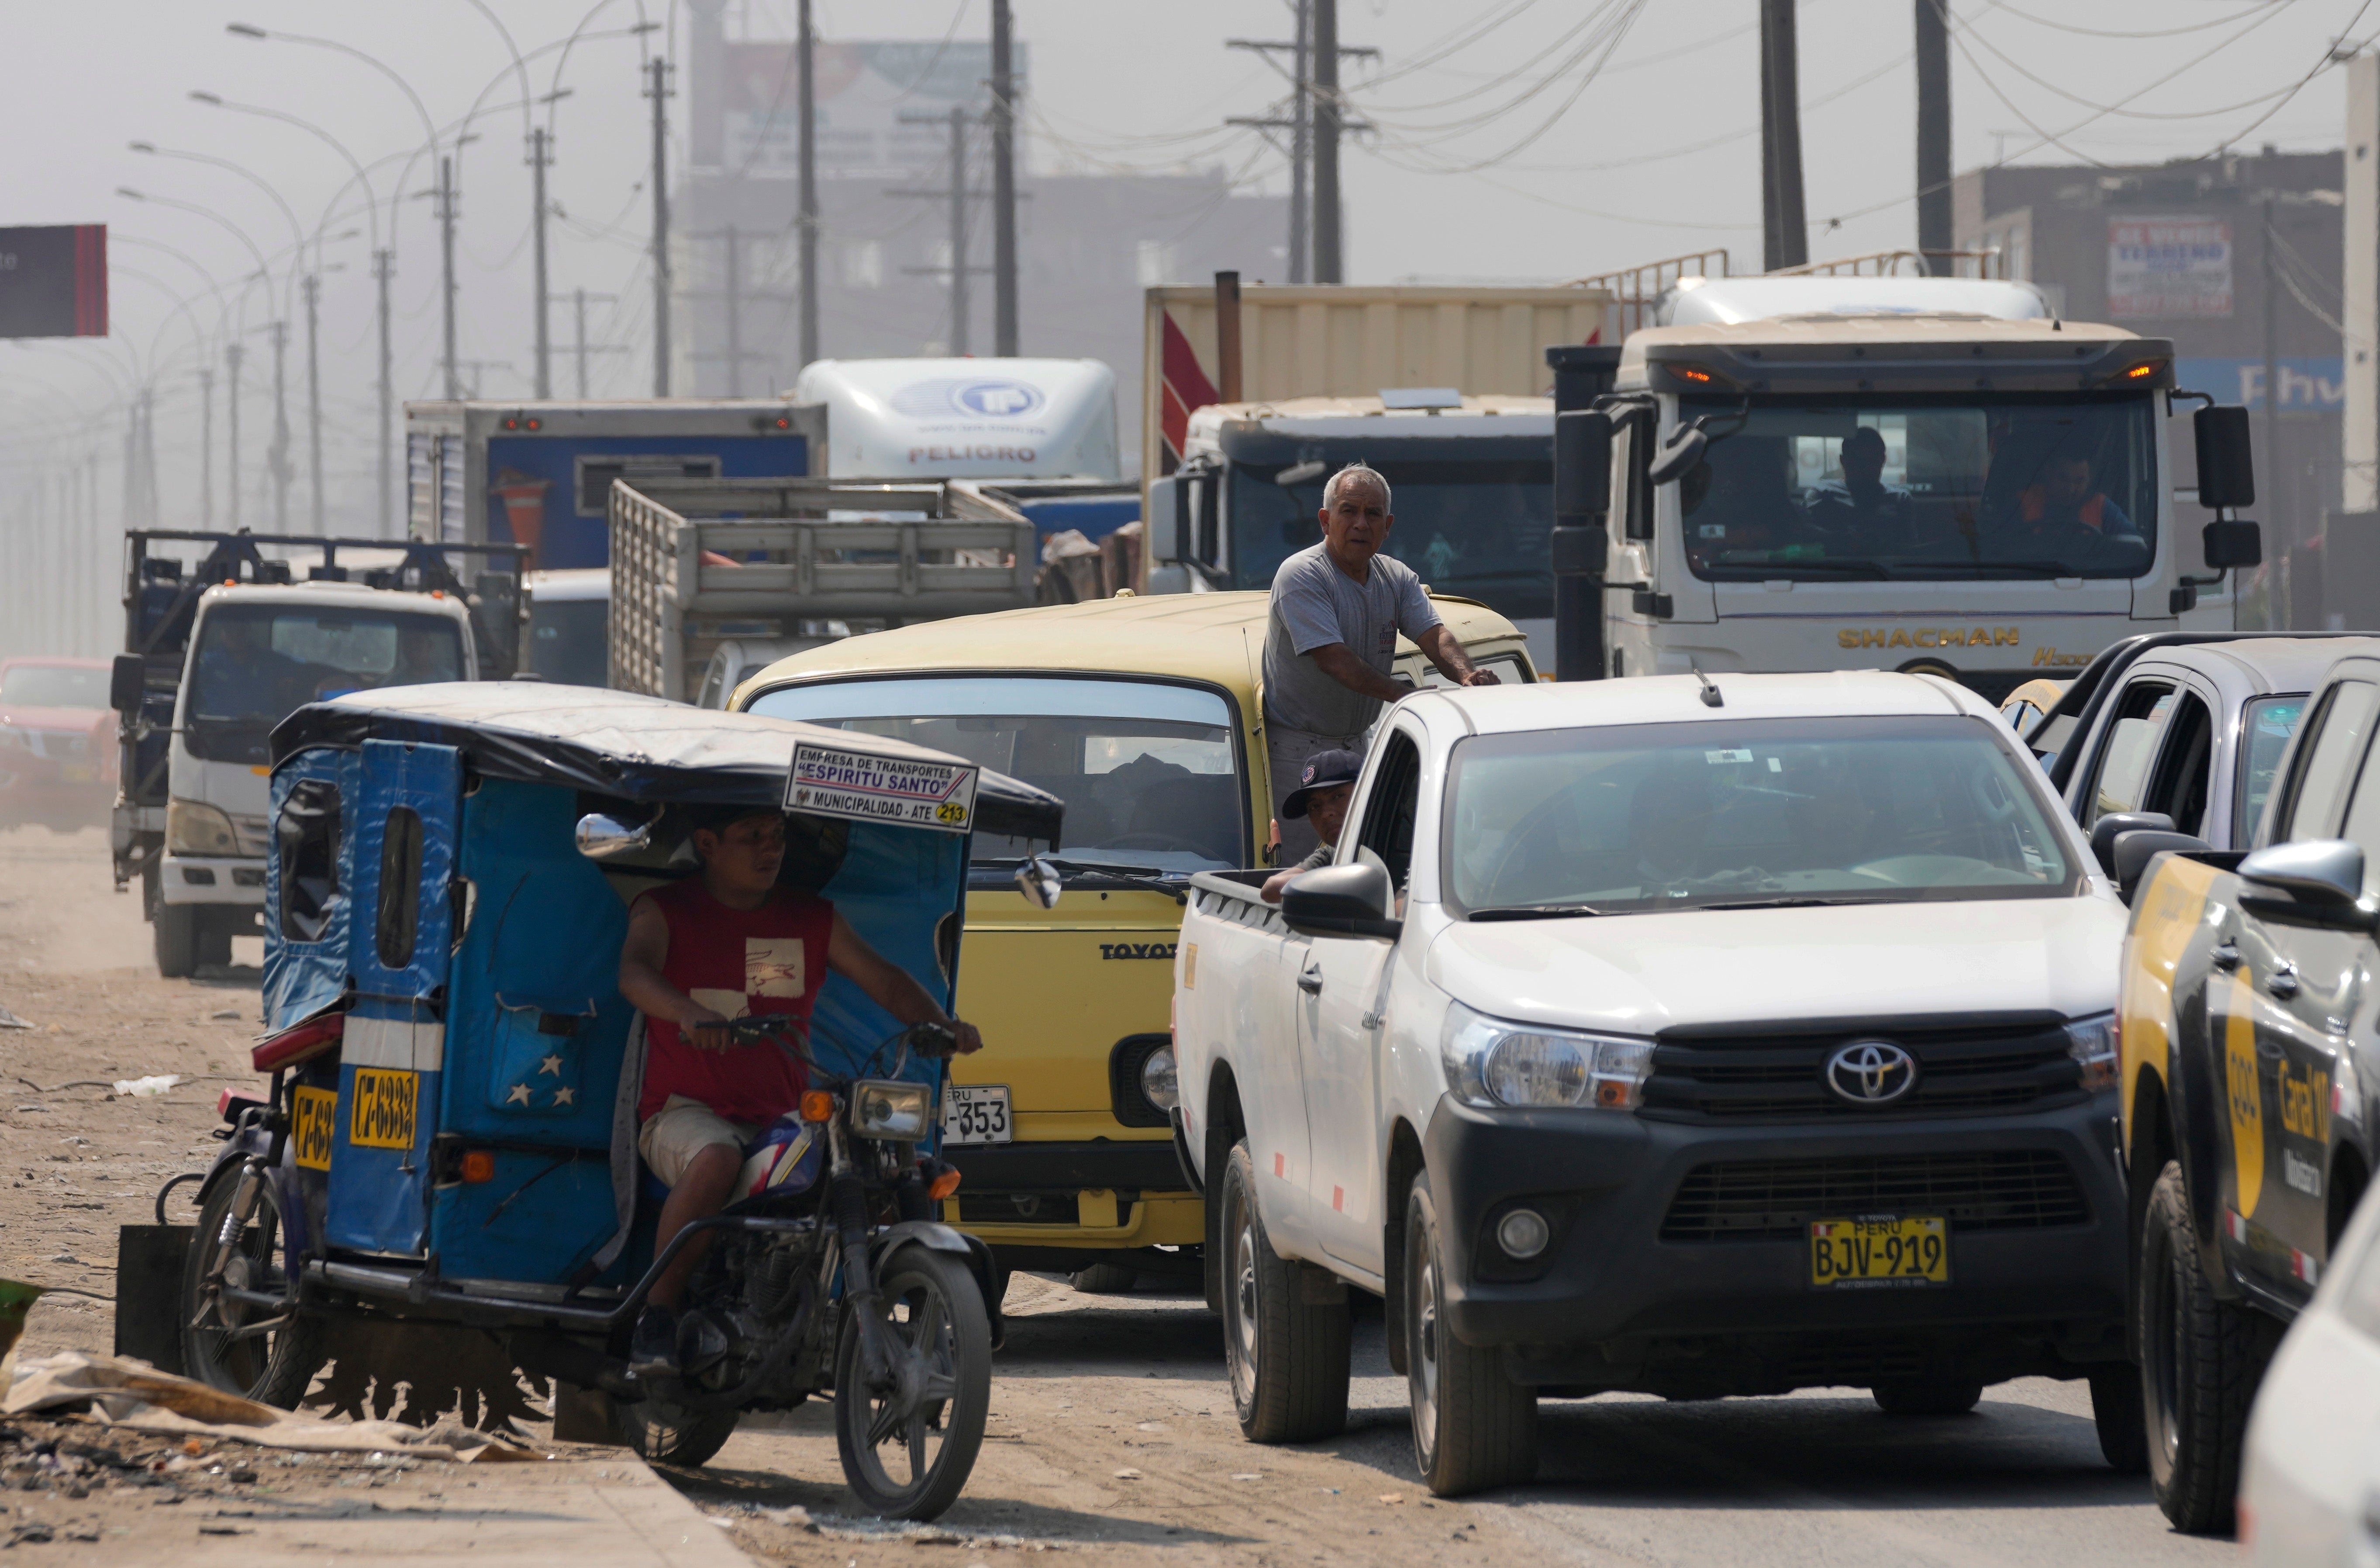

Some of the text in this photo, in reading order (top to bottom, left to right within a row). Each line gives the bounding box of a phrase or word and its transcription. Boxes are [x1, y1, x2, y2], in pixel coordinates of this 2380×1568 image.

[908, 445, 1036, 463] PELIGRO
[1838, 627, 2019, 648] SHACMAN
[2032, 647, 2097, 666] H300
[800, 749, 952, 779] EMPRESA DE TRANSPORTES
[814, 792, 903, 817] MUNICIPALIDAD
[911, 804, 932, 820] ATE
[939, 804, 964, 821] 213
[1099, 943, 1178, 960] TOYOT
[944, 1101, 1005, 1135] -353
[1815, 1234, 1942, 1277] BJV-919
